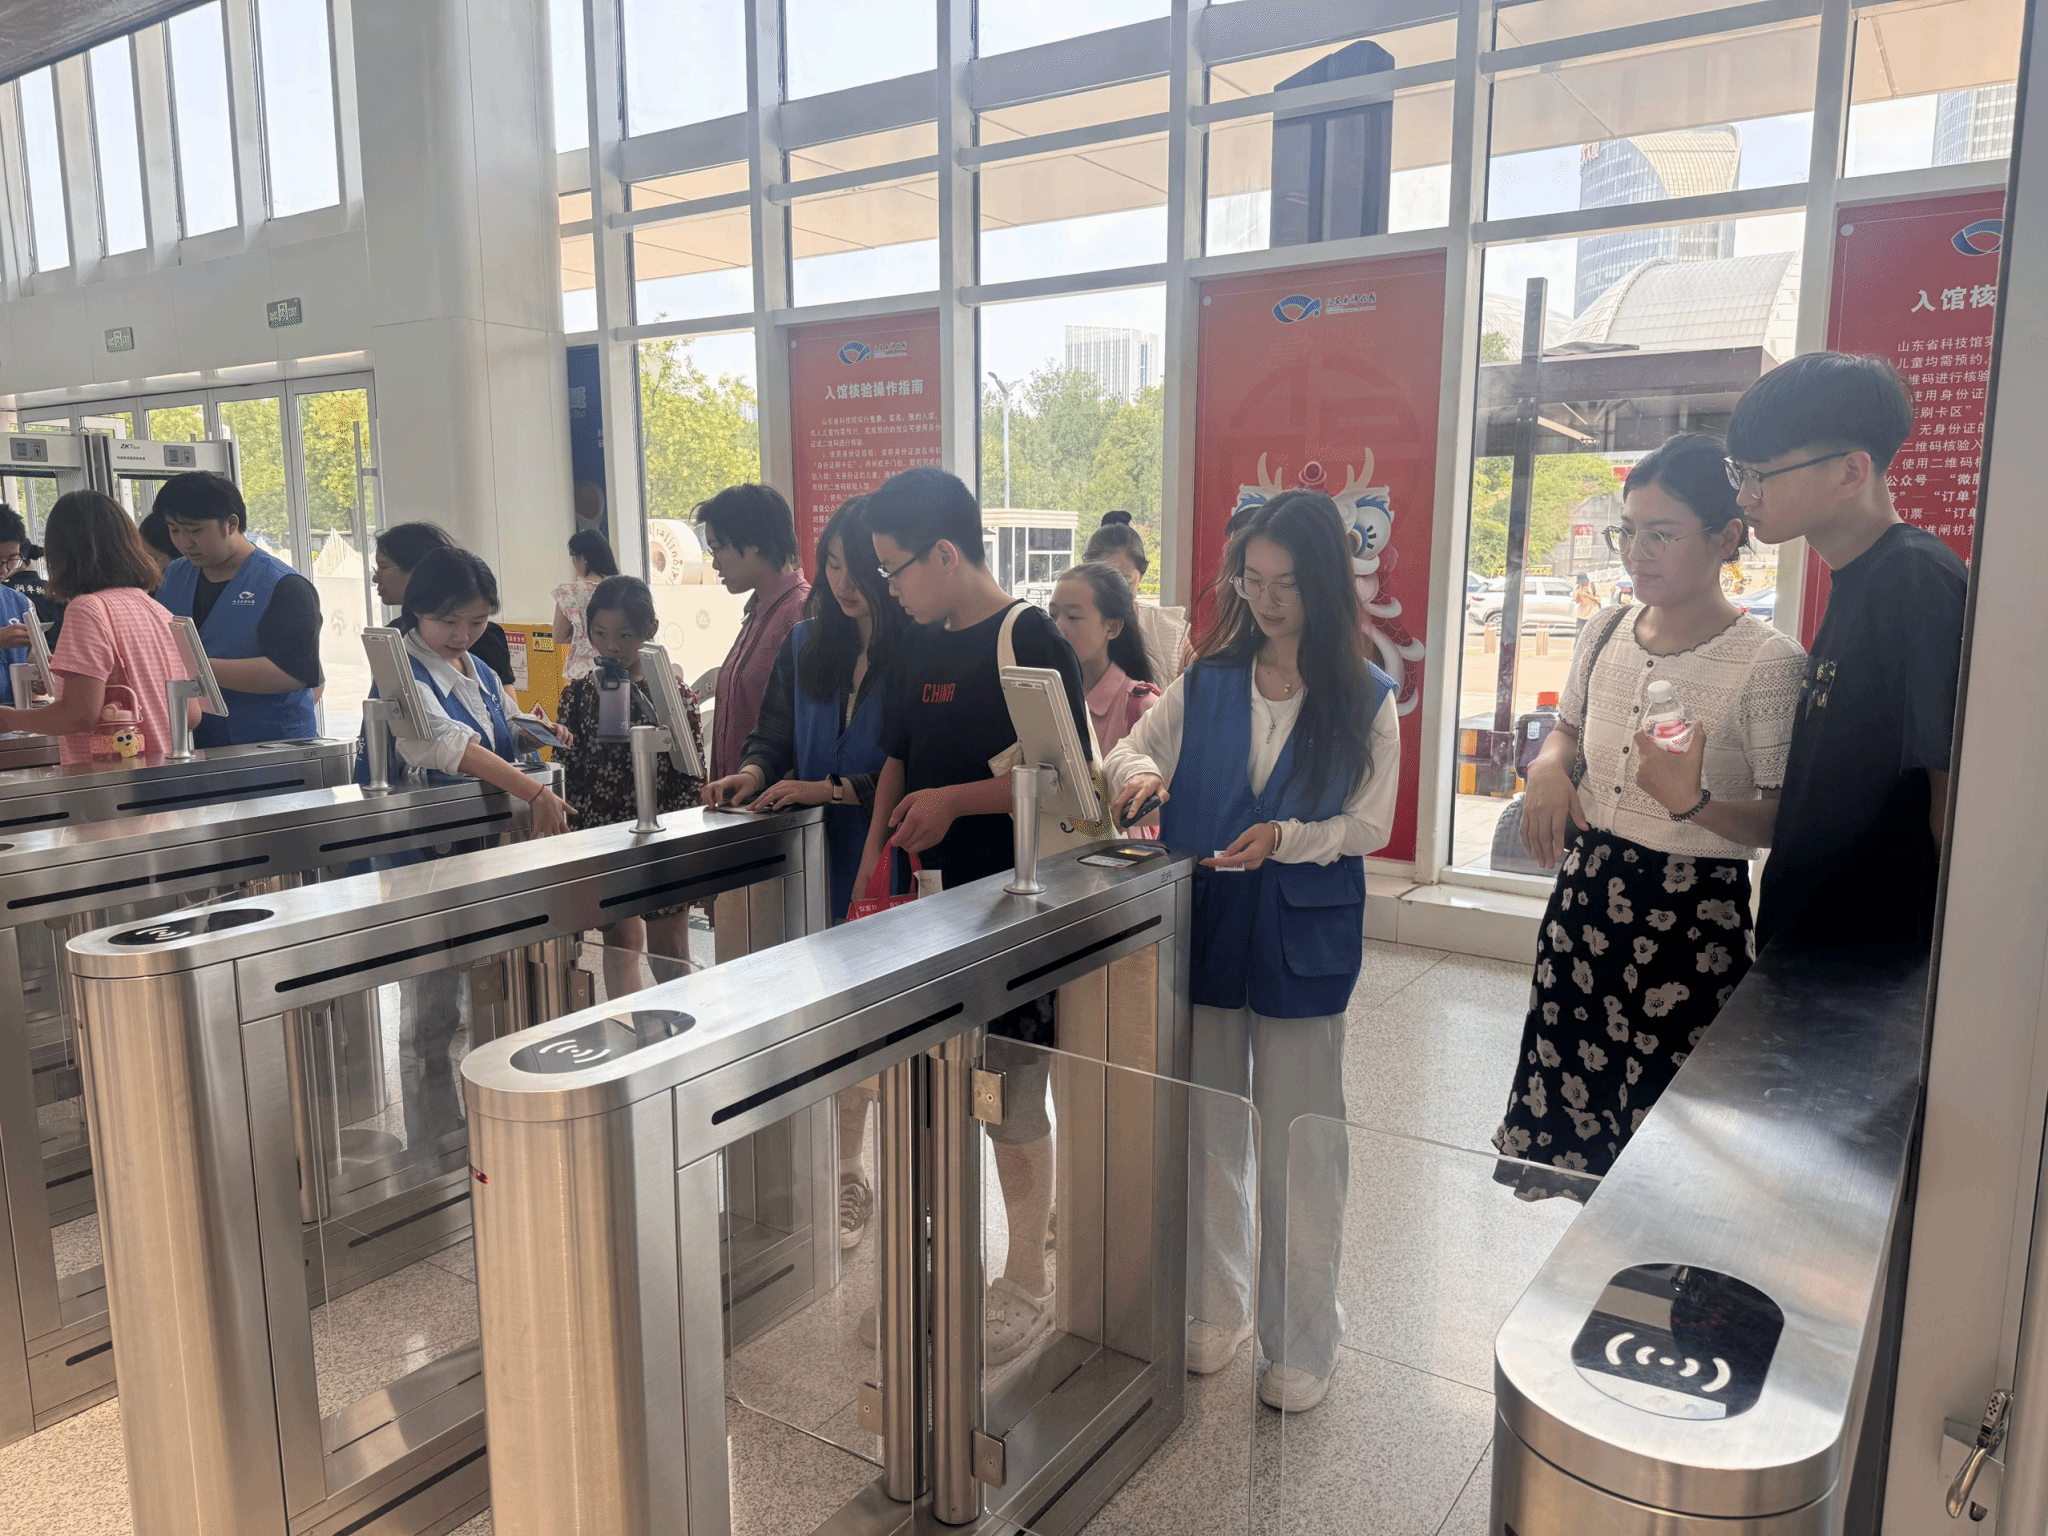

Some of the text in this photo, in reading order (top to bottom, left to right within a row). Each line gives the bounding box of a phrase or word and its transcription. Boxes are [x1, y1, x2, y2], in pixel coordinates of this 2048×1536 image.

[1911, 284, 1997, 313] 入馆核
[1888, 354, 1989, 370] 儿童均需预约。
[825, 378, 923, 401] 入馆核验操作指南
[1888, 457, 1982, 470] .使用二维码
[1918, 524, 1975, 536] 准闸机
[922, 683, 956, 703] CHINA
